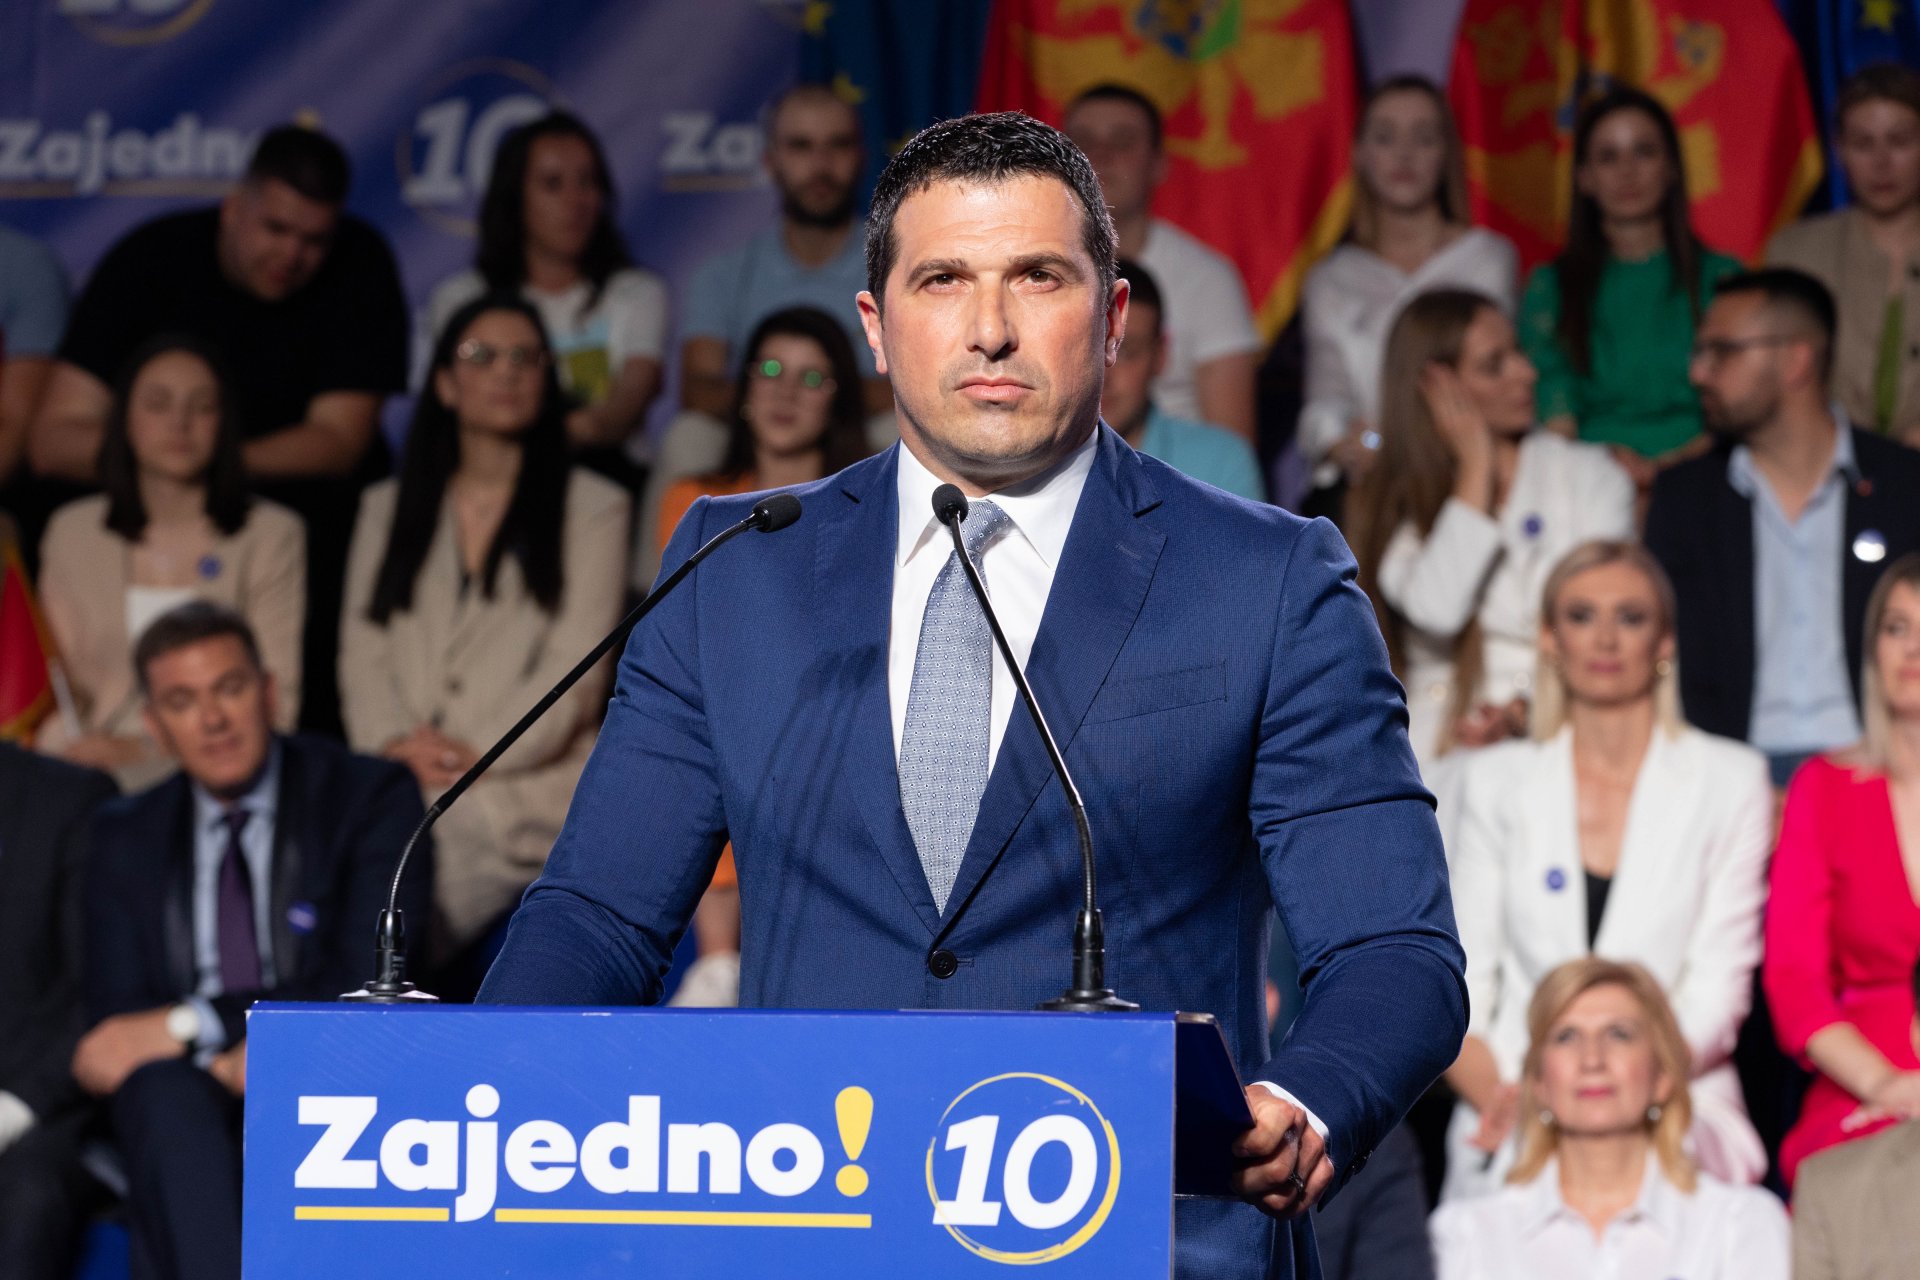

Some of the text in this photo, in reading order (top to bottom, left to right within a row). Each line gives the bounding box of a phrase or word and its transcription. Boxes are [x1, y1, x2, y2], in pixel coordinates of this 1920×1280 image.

[0, 108, 320, 197] Zajedn
[294, 1084, 1098, 1230] Zajedno! 10
